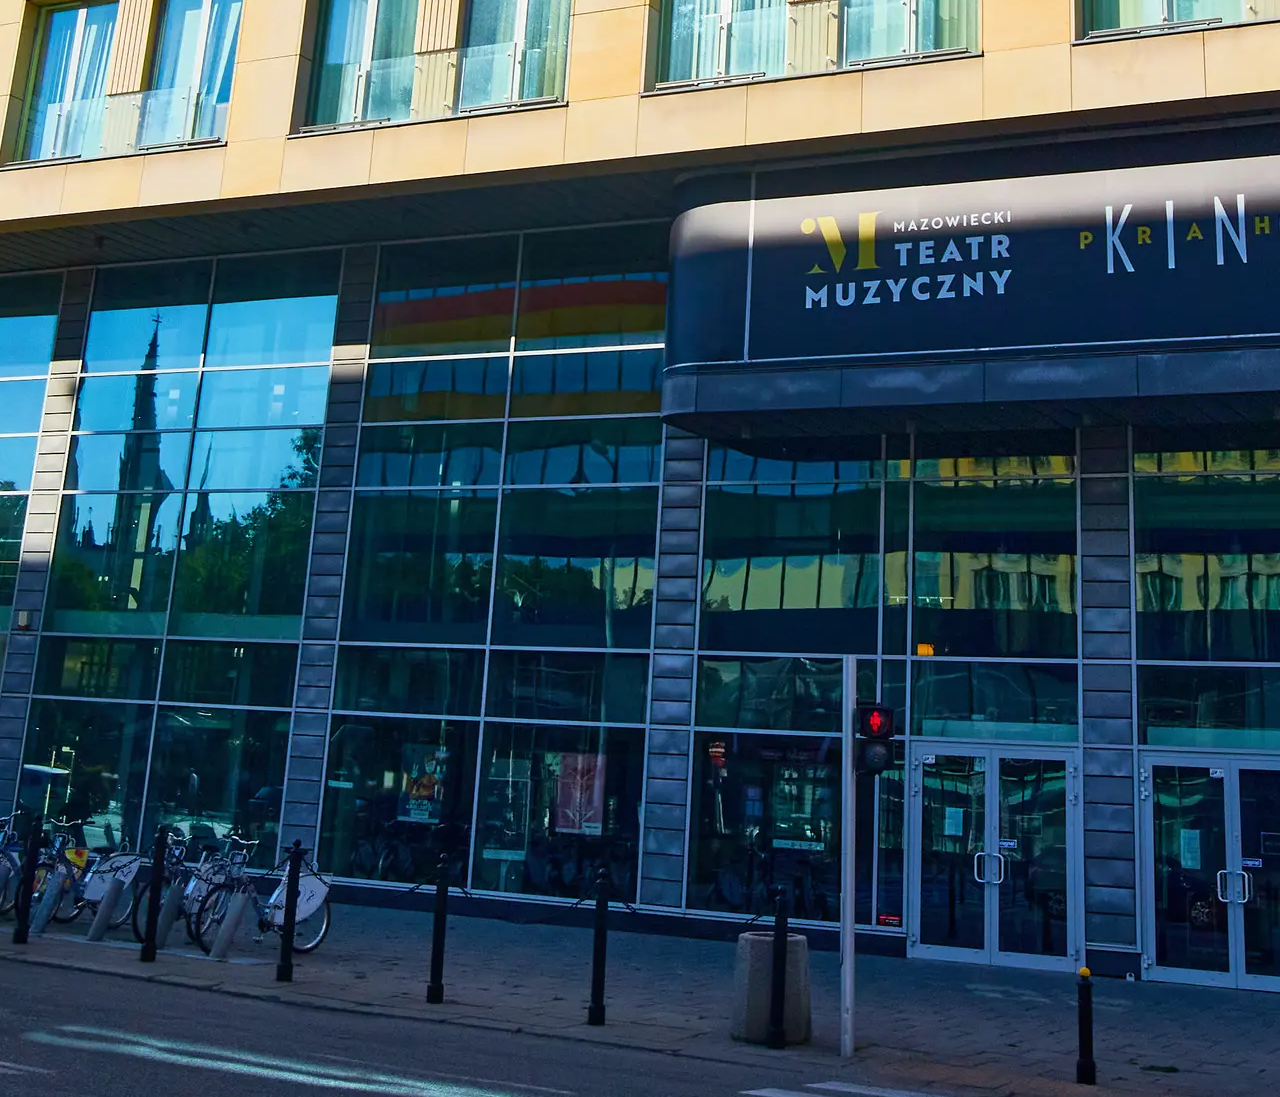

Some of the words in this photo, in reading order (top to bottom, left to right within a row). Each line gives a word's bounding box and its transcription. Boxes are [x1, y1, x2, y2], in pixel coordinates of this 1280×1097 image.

[893, 210, 1012, 233] MAZOWIECKI
[894, 234, 1010, 266] TEATR
[805, 269, 1012, 309] MUZYCZNY
